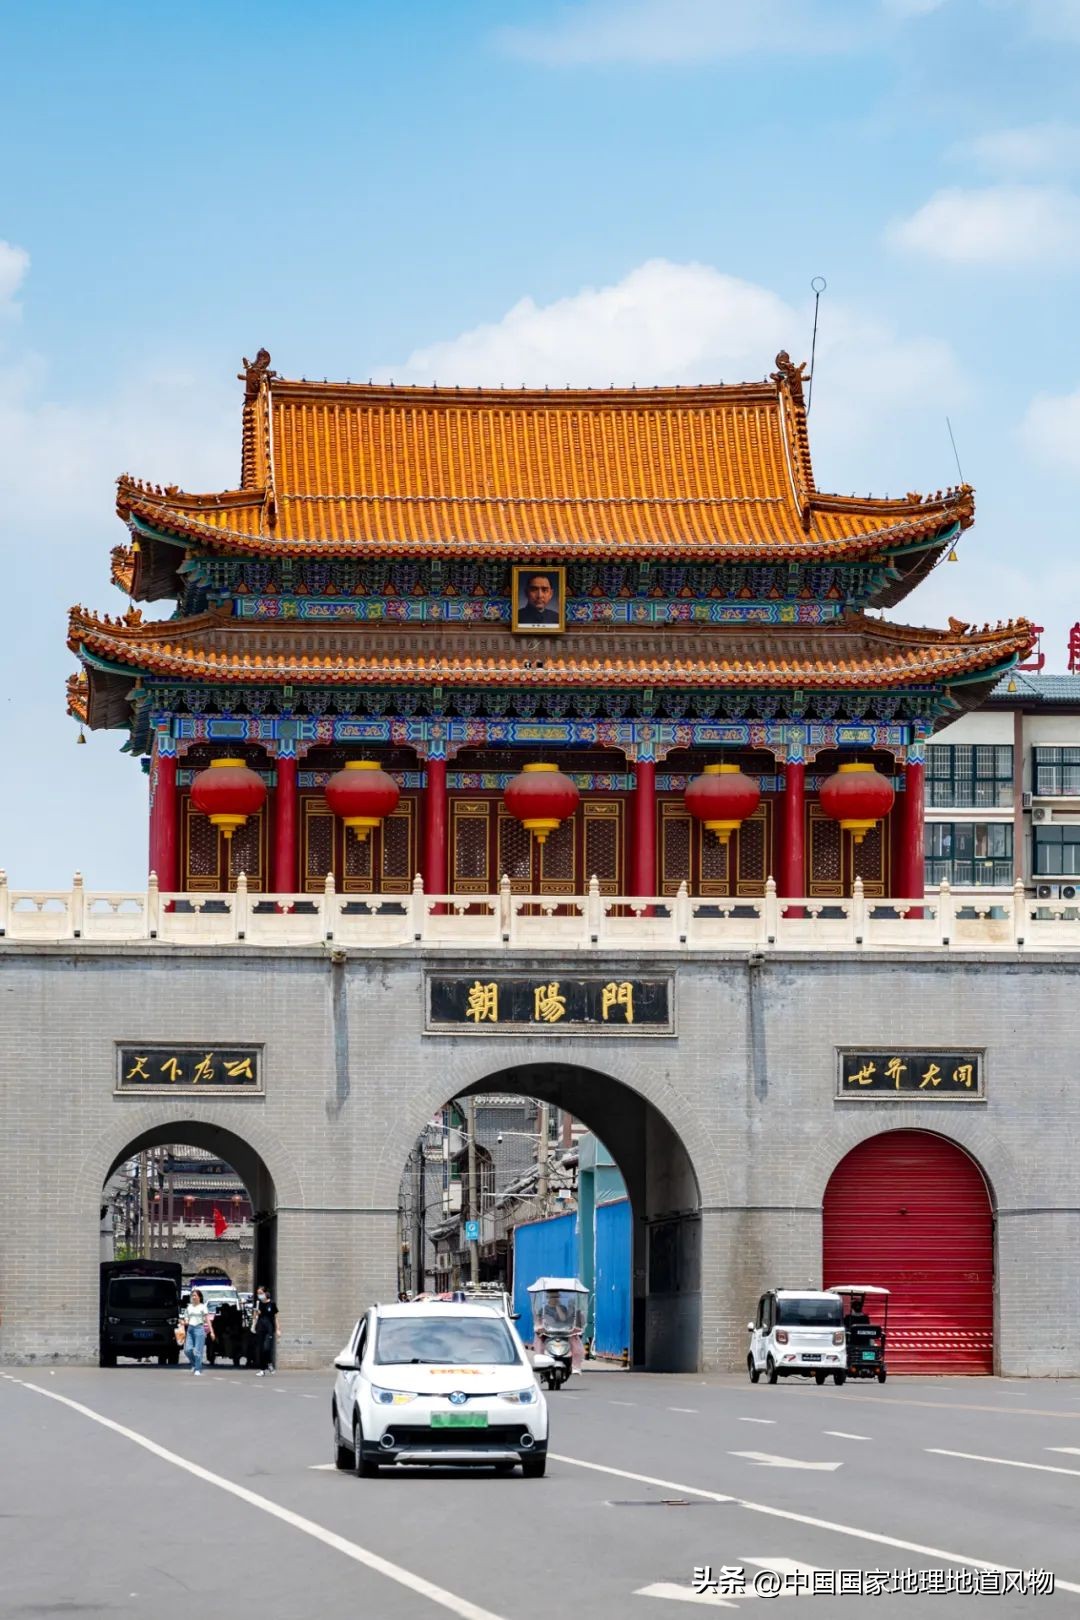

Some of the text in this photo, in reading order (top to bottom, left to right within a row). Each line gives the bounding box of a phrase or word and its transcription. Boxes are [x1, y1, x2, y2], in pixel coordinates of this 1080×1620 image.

[465, 980, 635, 1025] 朝陽門
[848, 1056, 973, 1090] 世界大同
